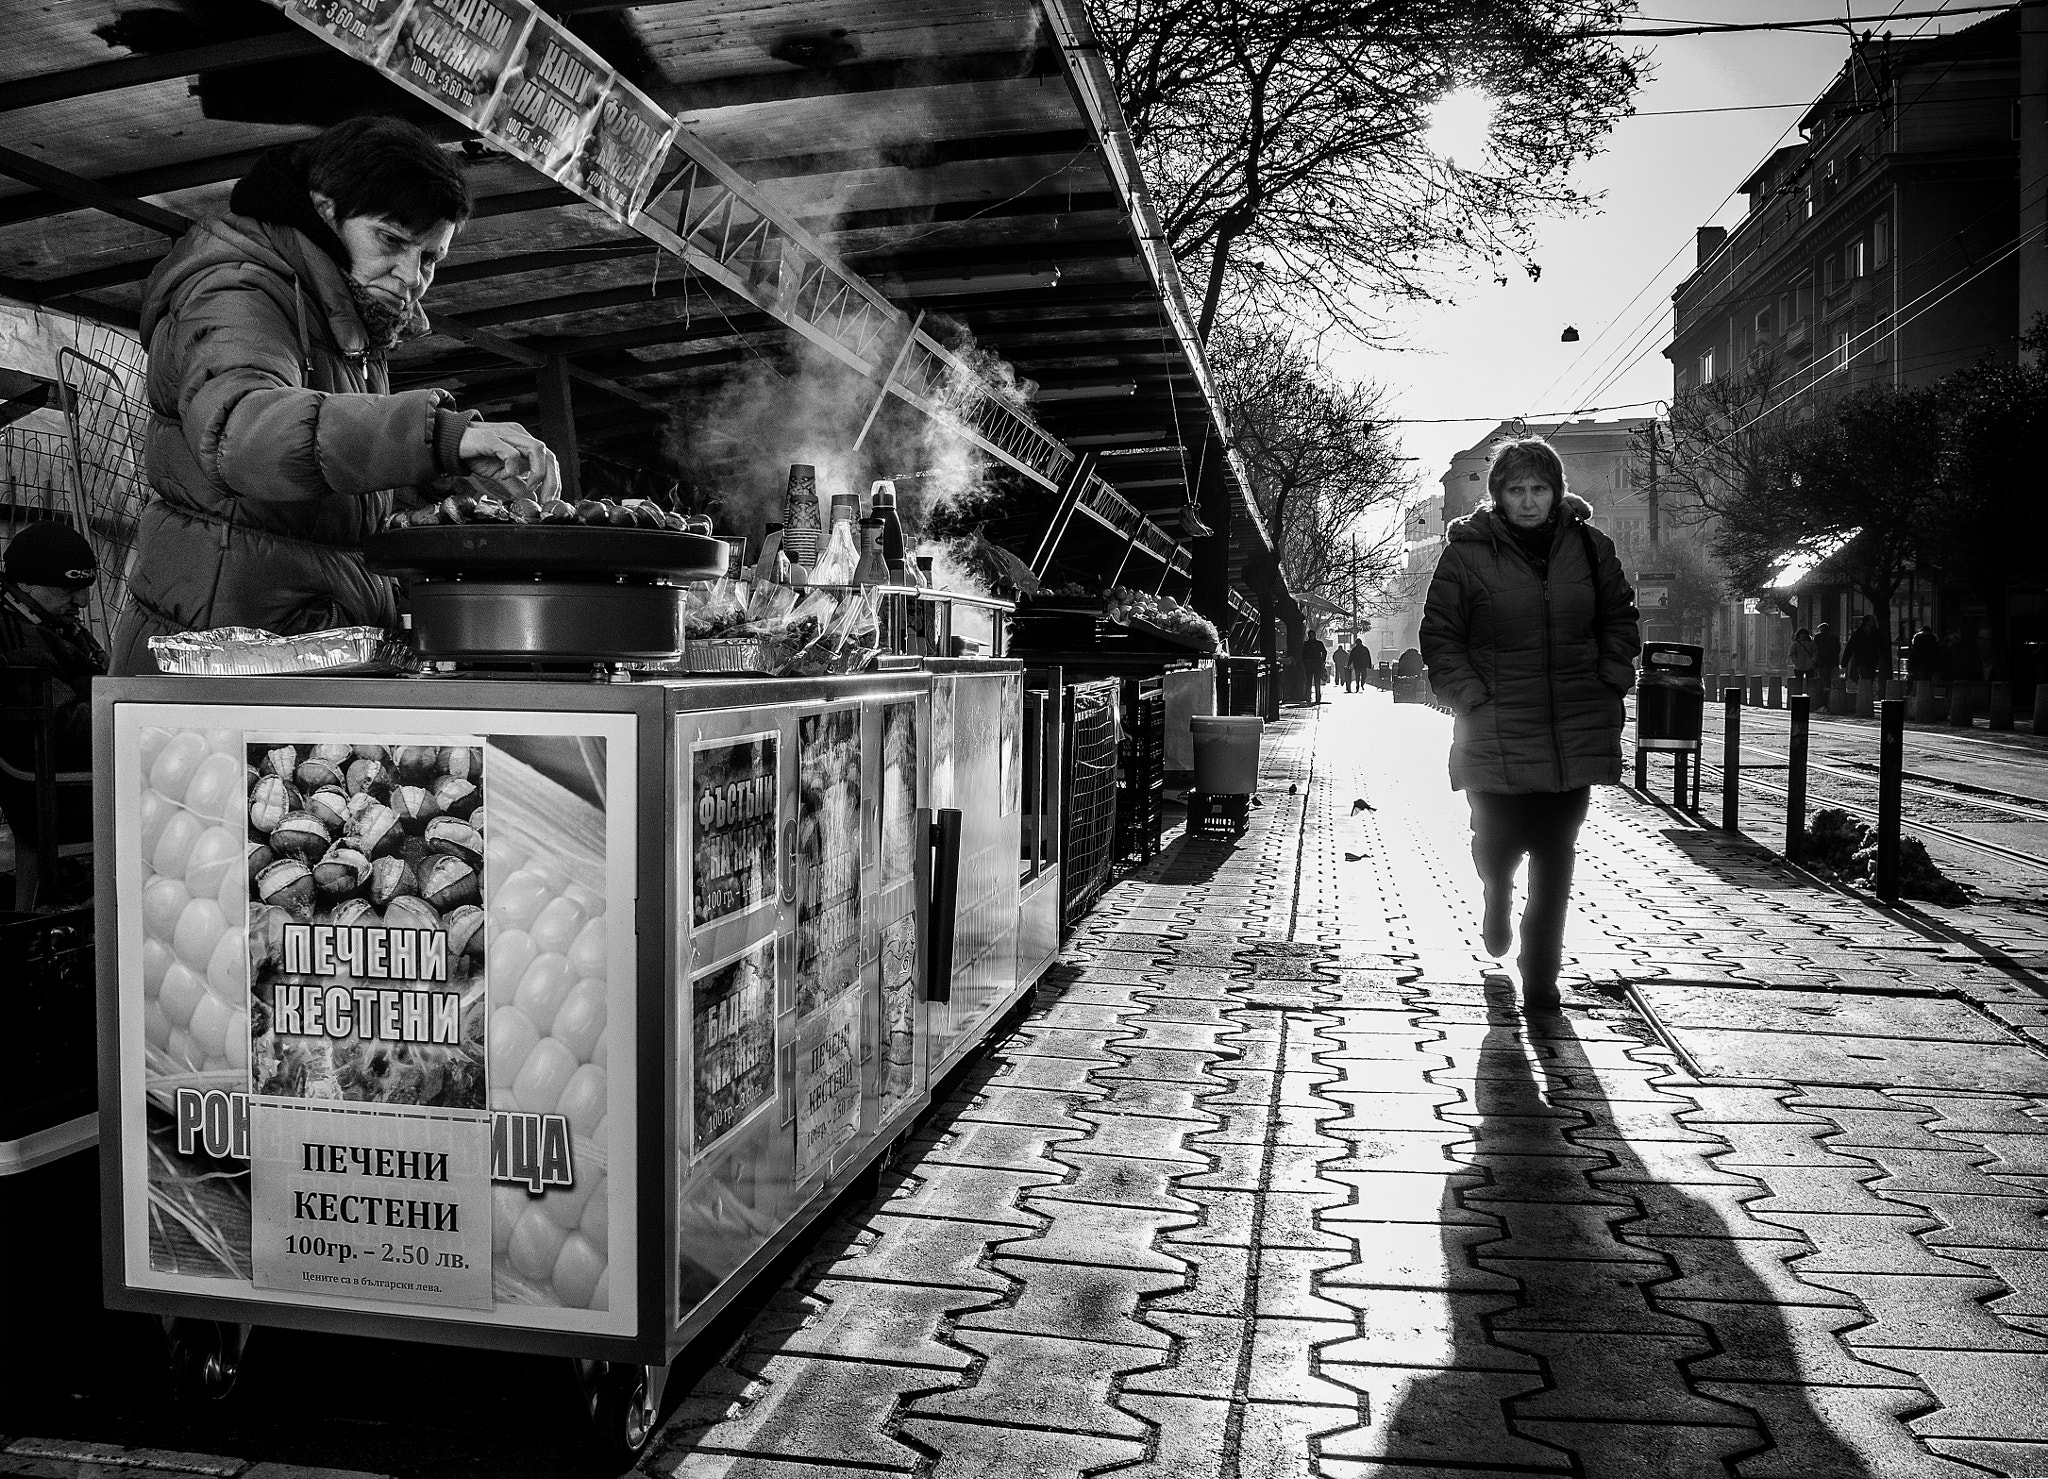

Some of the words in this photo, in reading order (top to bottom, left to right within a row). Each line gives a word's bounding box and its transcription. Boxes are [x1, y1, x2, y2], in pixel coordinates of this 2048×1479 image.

[326, 1, 354, 28] 3,60
[349, 19, 366, 40] лв.
[432, 0, 513, 50] АДЕМИ
[415, 12, 452, 58] НА
[442, 31, 491, 81] ЖАР
[410, 55, 427, 77] 100
[425, 66, 437, 85] гр.
[441, 75, 462, 99] 3,60
[460, 89, 474, 108] лв.
[538, 41, 594, 103] КАШУ
[506, 117, 522, 137] 100
[512, 81, 546, 123] НА
[538, 98, 579, 142] ЖАР
[699, 775, 773, 831] ФЪСТЪЦИ
[710, 834, 731, 880] НА
[707, 890, 722, 911] 100
[284, 923, 447, 982] ПЕЧЕНИ
[274, 984, 460, 1045] КЕСТЕНИ
[809, 1058, 853, 1116] КЕСТЕНИ
[178, 1089, 251, 1159] РОН
[490, 1111, 573, 1194] ИЦА
[708, 1109, 723, 1133] 100
[302, 1142, 449, 1182] ПЕЧЕНИ
[294, 1190, 459, 1232] КЕСТЕНИ
[285, 1235, 358, 1264] 100гр.
[381, 1243, 430, 1266] 2.50
[435, 1252, 470, 1269] лв.
[302, 1271, 339, 1284] Цените
[340, 1275, 351, 1284] са
[361, 1276, 414, 1290] български
[415, 1284, 443, 1293] лева.
